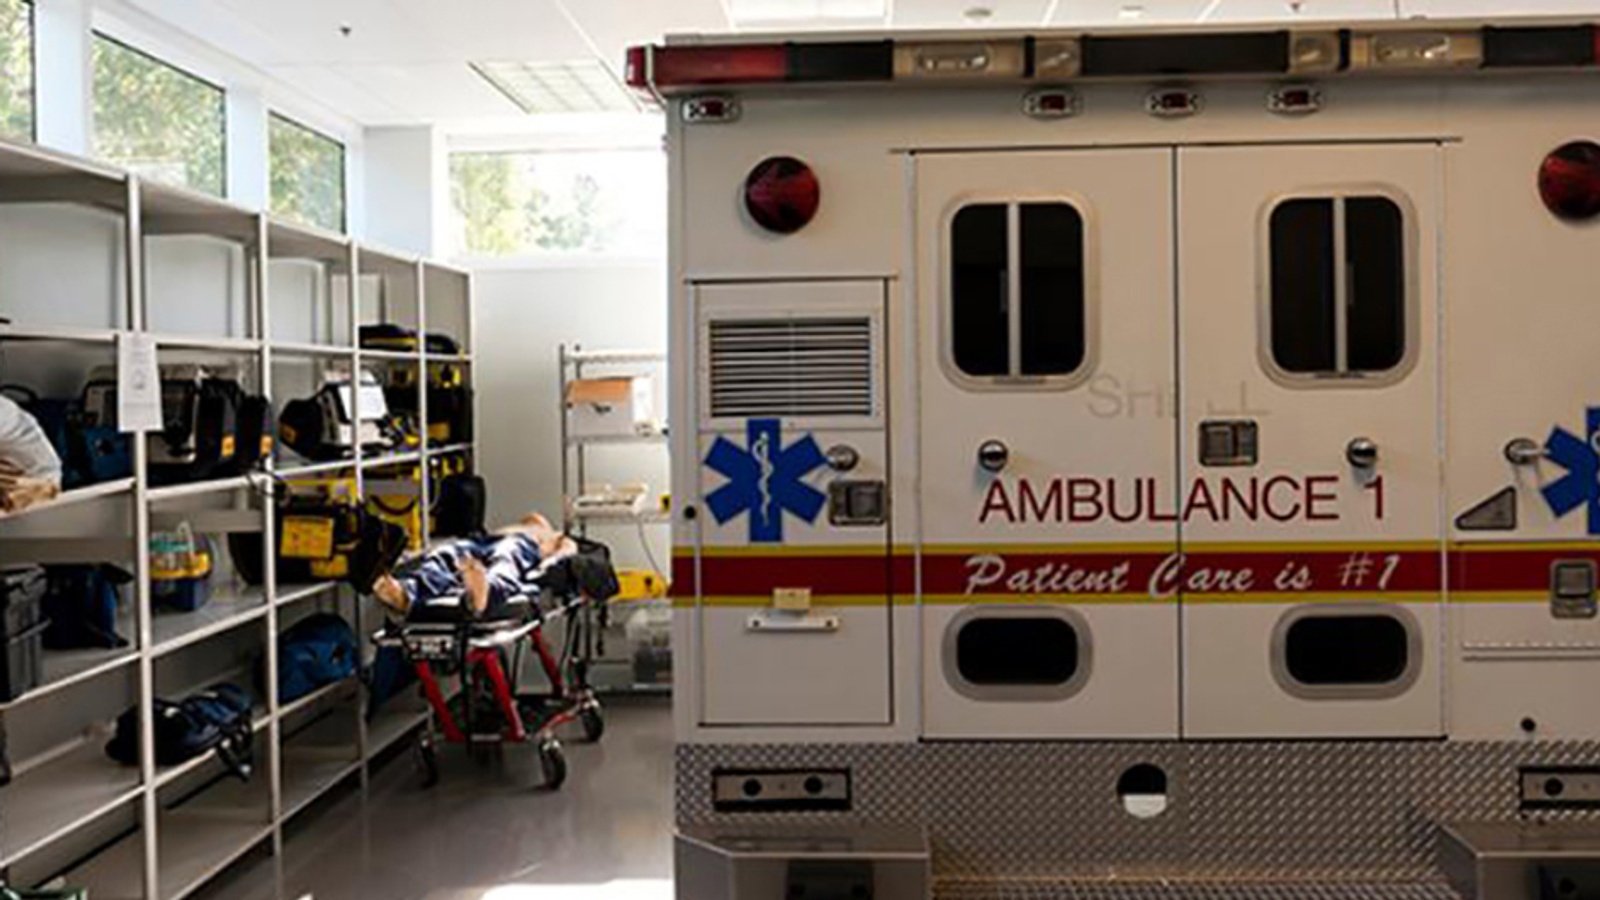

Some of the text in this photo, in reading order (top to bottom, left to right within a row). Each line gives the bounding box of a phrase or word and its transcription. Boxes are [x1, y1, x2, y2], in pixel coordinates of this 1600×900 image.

[1086, 373, 1271, 419] SHLL
[979, 476, 1385, 522] AMBULANCE 1
[964, 552, 1400, 598] Patient Care is #1
